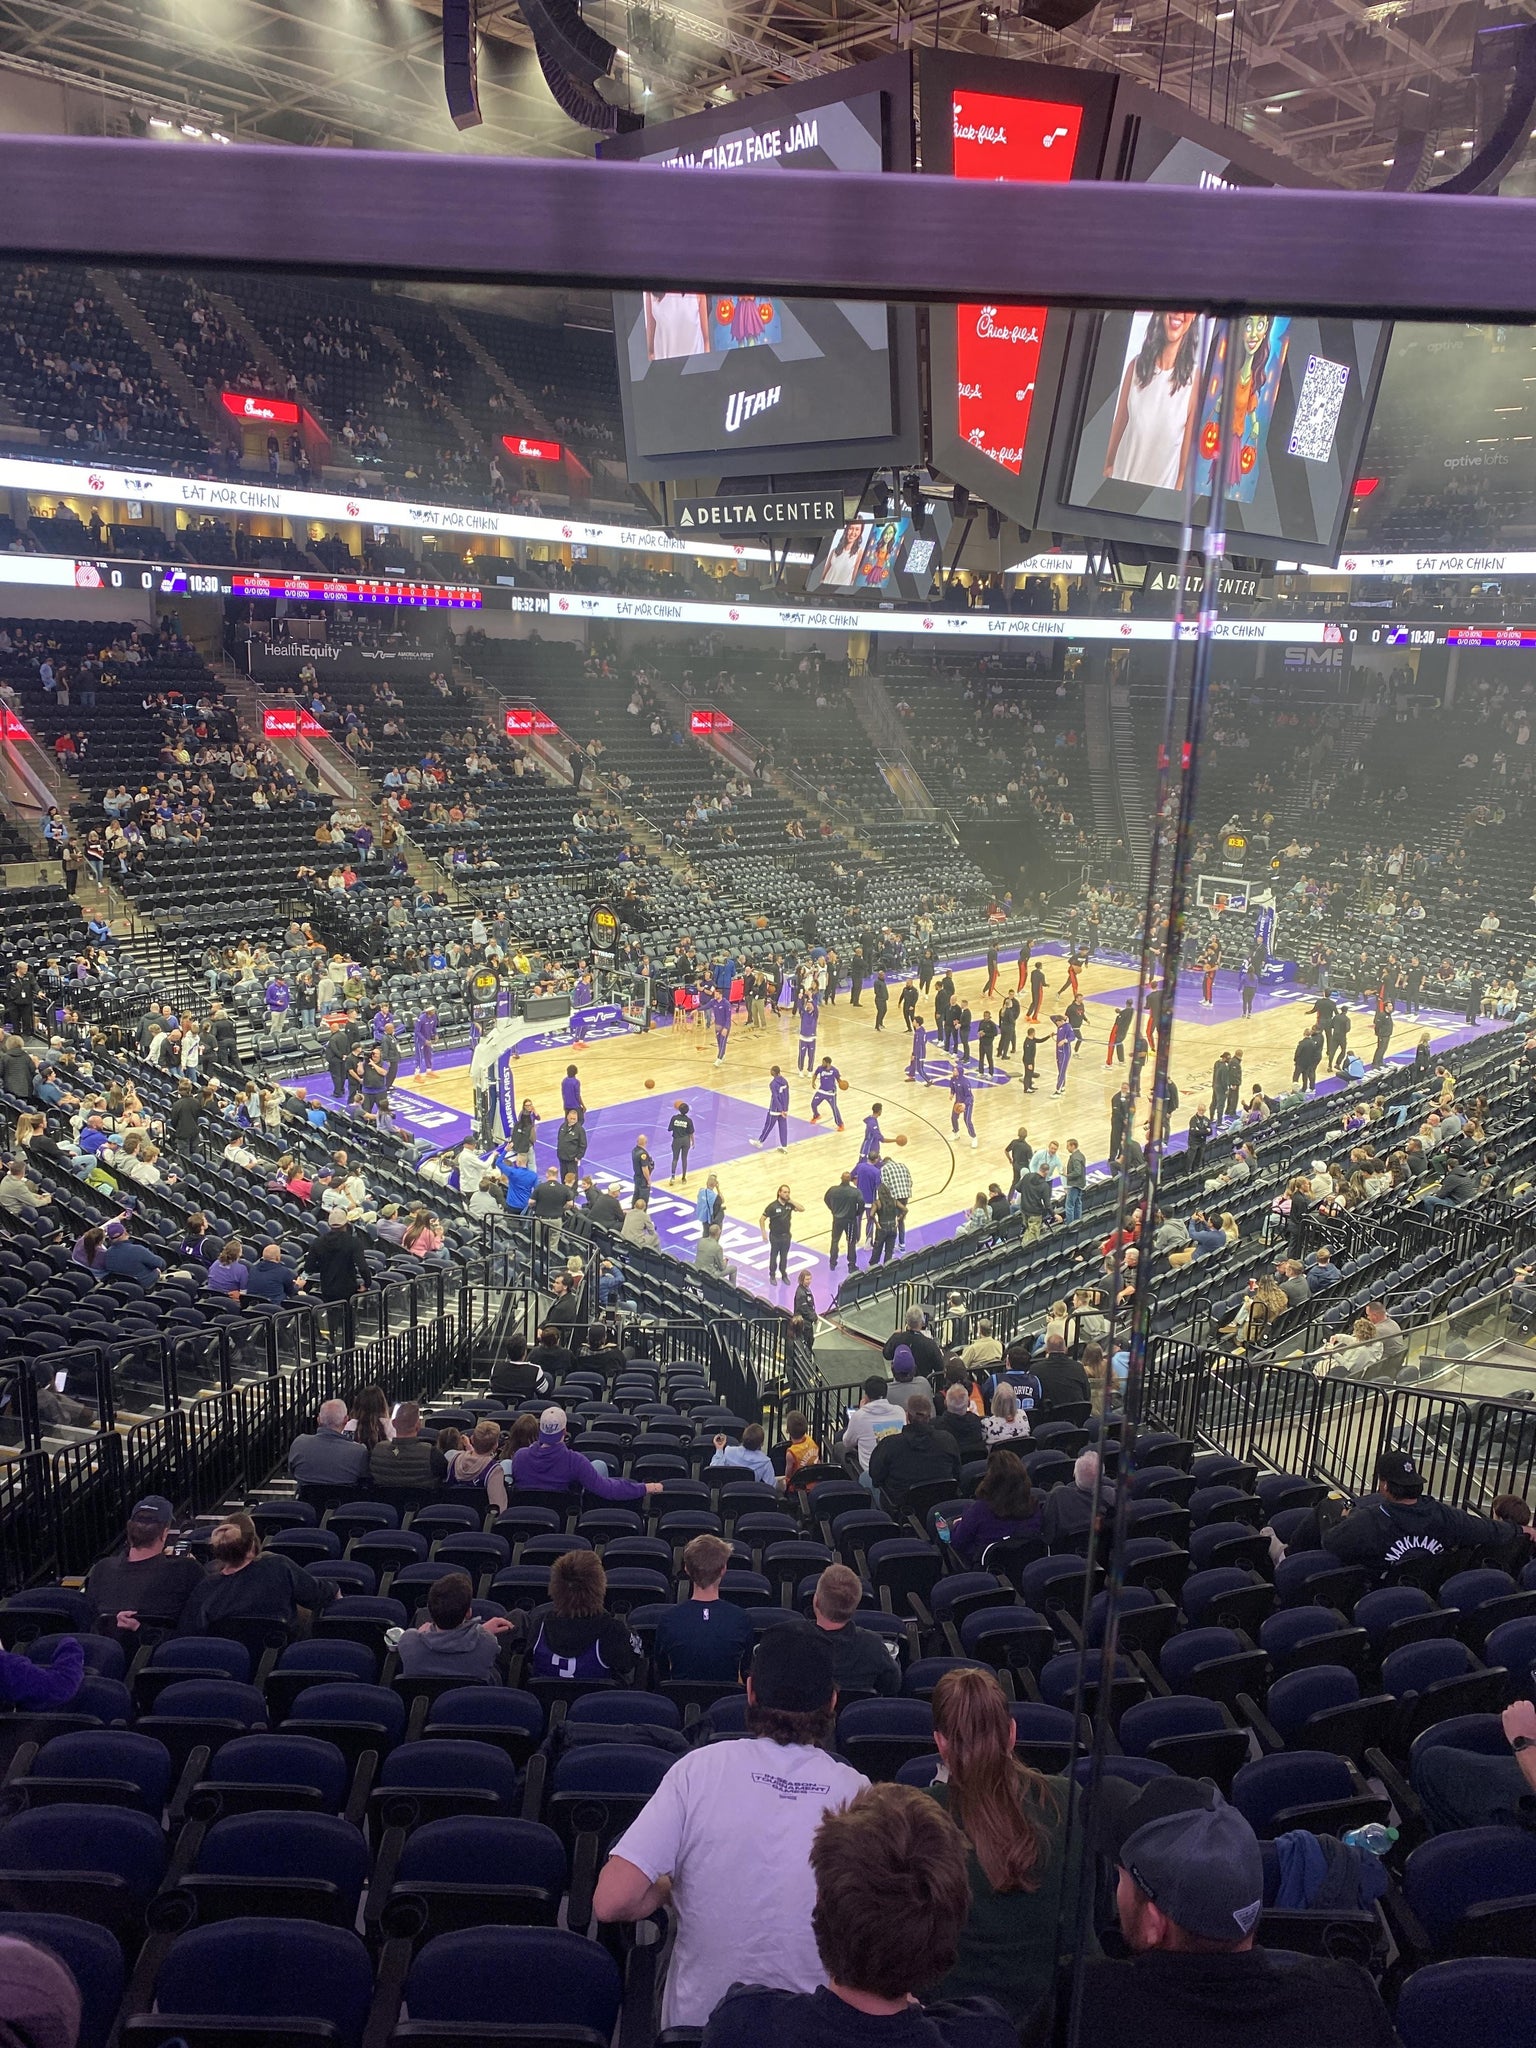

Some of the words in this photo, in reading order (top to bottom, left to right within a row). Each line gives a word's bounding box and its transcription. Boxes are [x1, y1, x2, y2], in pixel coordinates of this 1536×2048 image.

[953, 117, 1007, 144] hick-fil-A
[746, 130, 781, 164] FACE
[784, 120, 818, 154] JAM
[976, 312, 1039, 343] Chick-fil-A
[725, 385, 782, 432] UTAH
[1443, 455, 1482, 470] aptive
[1483, 452, 1509, 465] lofts
[182, 485, 206, 501] EAT
[210, 488, 237, 505] MOR
[239, 491, 280, 509] CHIKIN
[443, 512, 465, 528] MOR
[465, 514, 500, 531] CHIKIN
[697, 505, 757, 524] DELTA
[763, 501, 835, 522] CENTER
[621, 532, 636, 544] EAT
[638, 534, 656, 547] MOR
[657, 536, 686, 550] CHIKIN
[1039, 558, 1073, 570] CHIKIN
[1416, 558, 1438, 570] EAT
[1439, 557, 1464, 570] MOR
[1466, 557, 1505, 570] CHIKIN
[111, 570, 123, 587] 0
[141, 571, 152, 589] 0
[189, 574, 219, 593] 10:30
[1217, 577, 1256, 596] ENTER
[511, 596, 535, 613] 06:52
[535, 598, 548, 612] PM
[617, 602, 632, 615] EAT
[634, 603, 652, 616] MOR
[653, 604, 682, 618] CHIKIN
[807, 614, 828, 625] MOR
[829, 614, 859, 626] CHIKIN
[988, 620, 1008, 632] EAT
[1008, 621, 1030, 633] MOR
[1031, 621, 1064, 634] CHIKIN
[1213, 624, 1229, 634] OR
[1231, 625, 1265, 637] CHIKIN
[1350, 629, 1358, 642] 0
[1372, 629, 1381, 643] 0
[1410, 630, 1435, 645] 10:30
[264, 643, 340, 661] HealthEquity
[1284, 646, 1344, 667] SME
[503, 1066, 511, 1091] FIRST
[504, 1090, 515, 1129] AMERICA
[1384, 1535, 1445, 1562] MARKKANE
